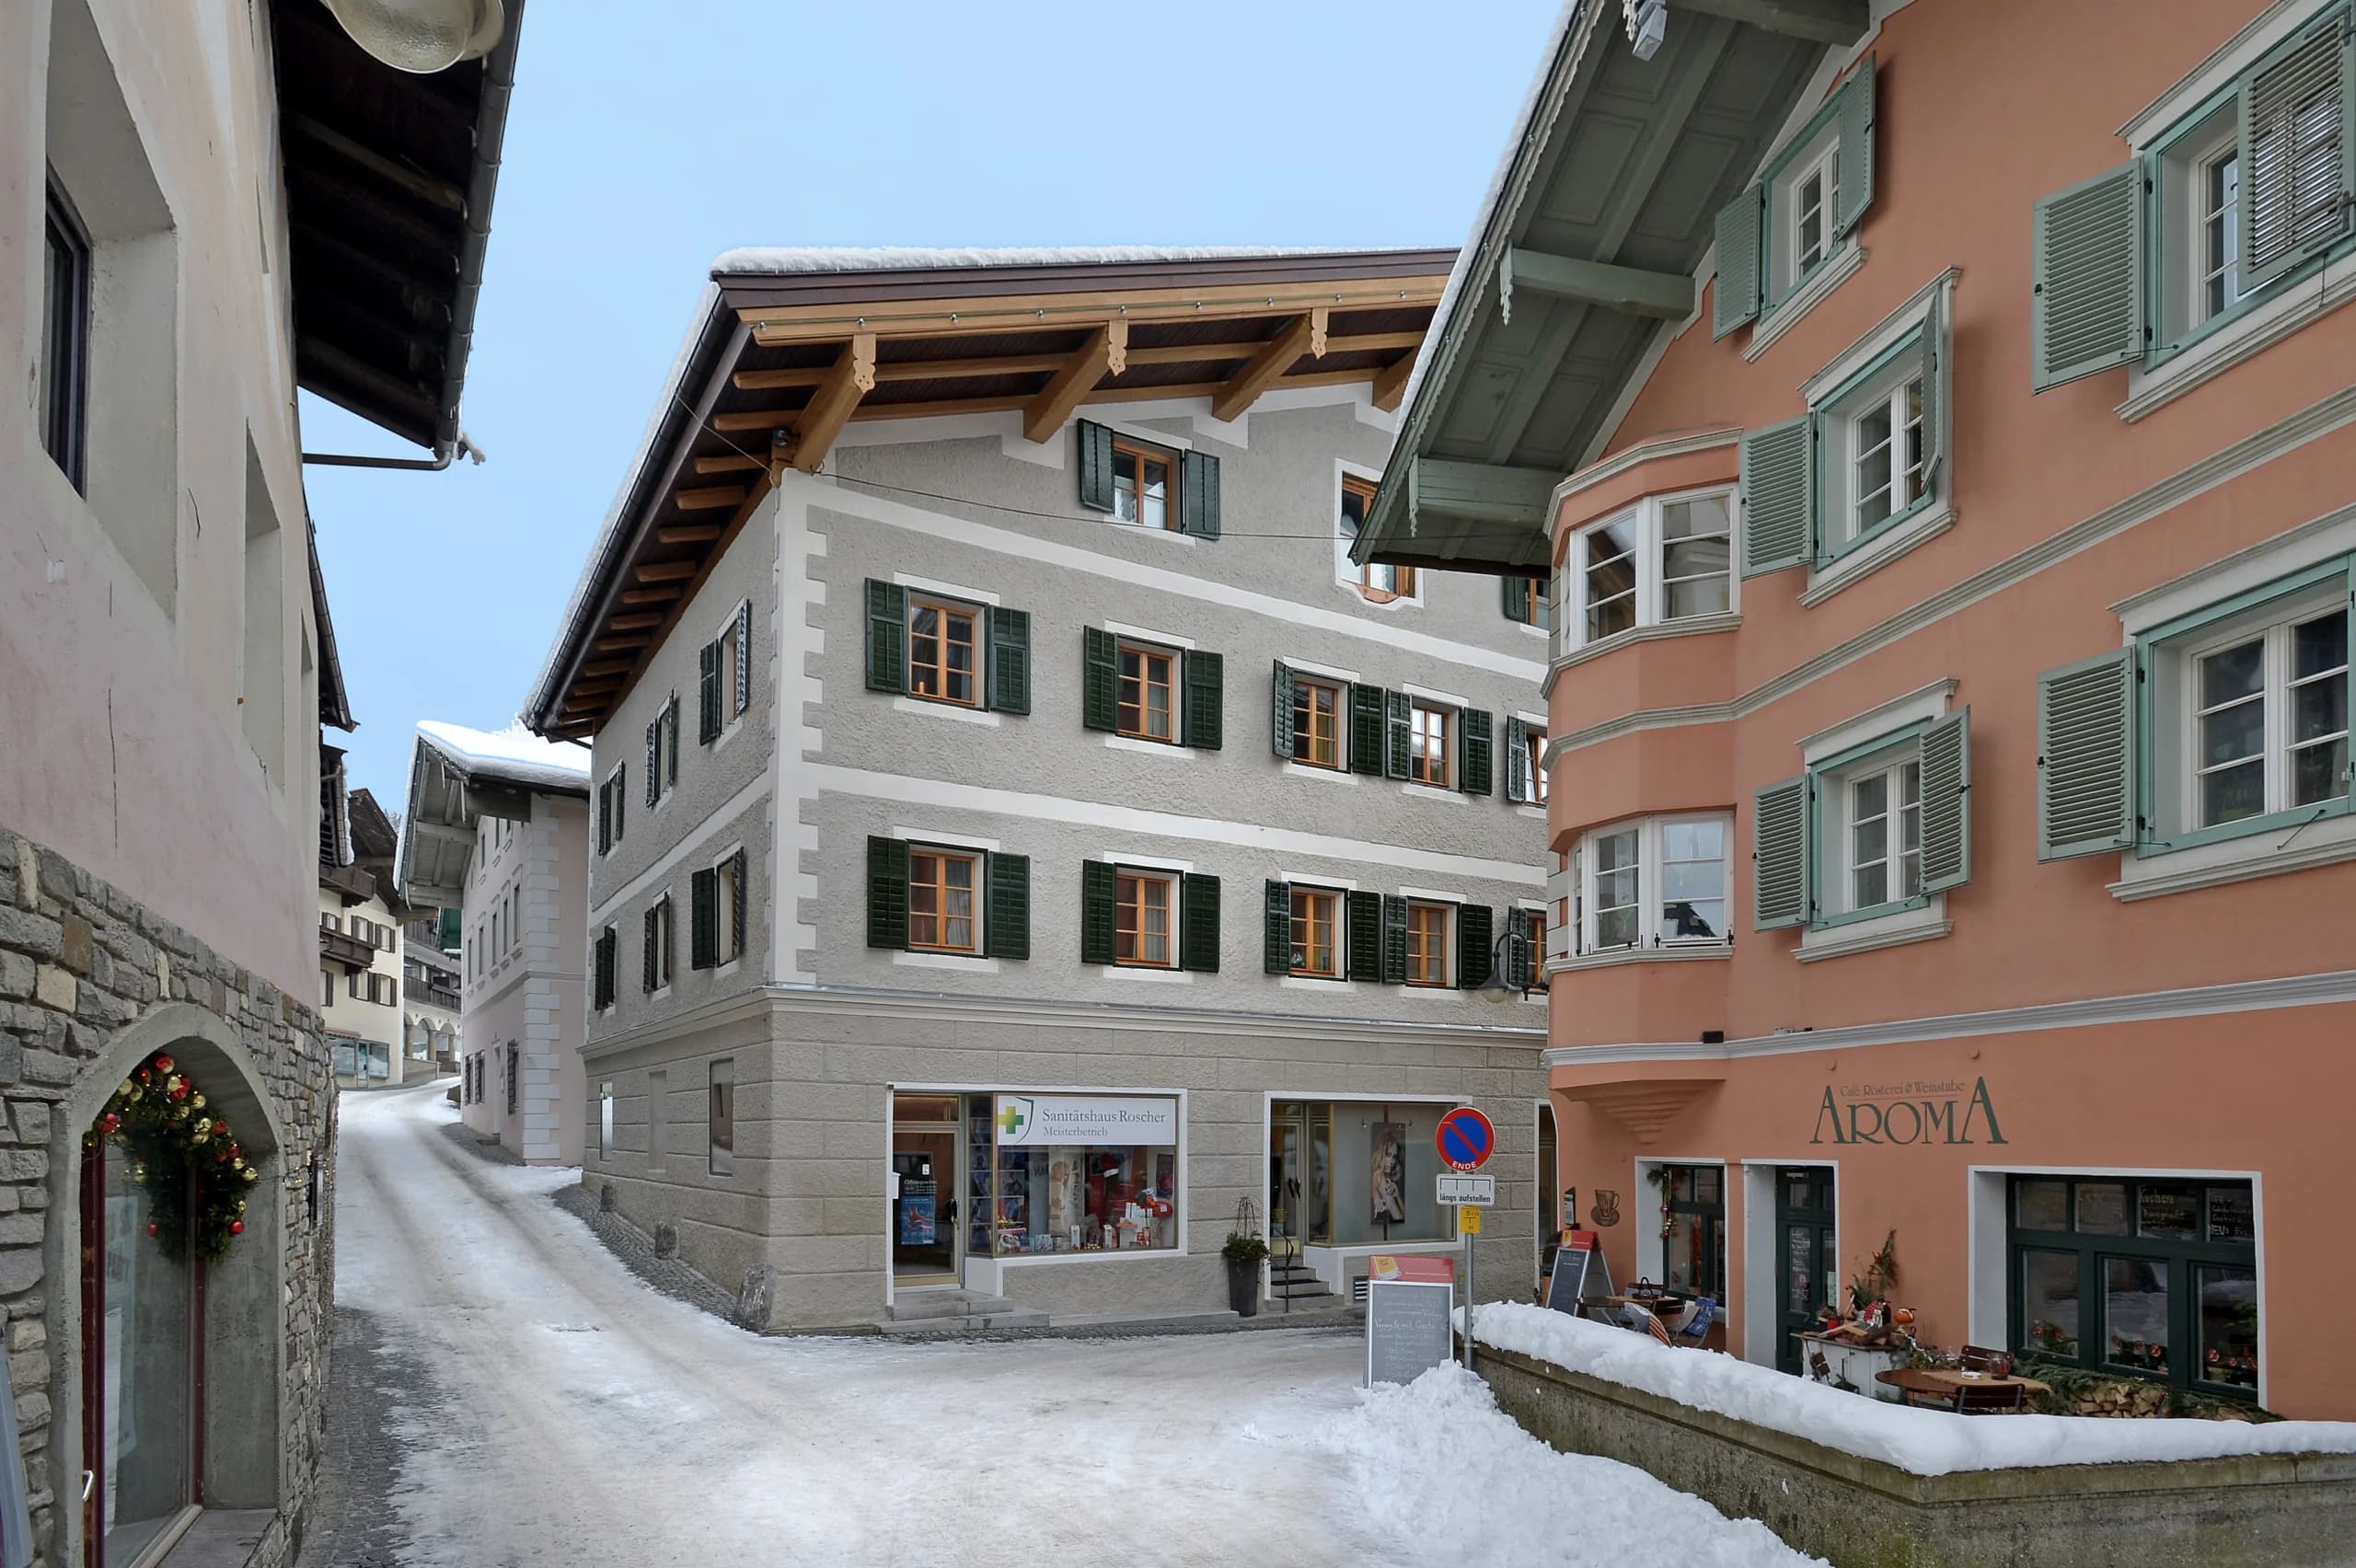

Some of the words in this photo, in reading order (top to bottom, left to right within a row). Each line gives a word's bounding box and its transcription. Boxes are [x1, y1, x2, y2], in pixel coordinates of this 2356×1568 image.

[1914, 1079, 1966, 1092] Weinstube
[1042, 1108, 1117, 1123] Sanitätshaus
[1119, 1110, 1166, 1123] Roscher
[1809, 1076, 2009, 1145] AROMA
[1043, 1126, 1108, 1137] Meisterbetrieb
[1452, 1160, 1477, 1170] ENDE
[1439, 1193, 1457, 1203] längs
[1459, 1194, 1491, 1203] aufstellen
